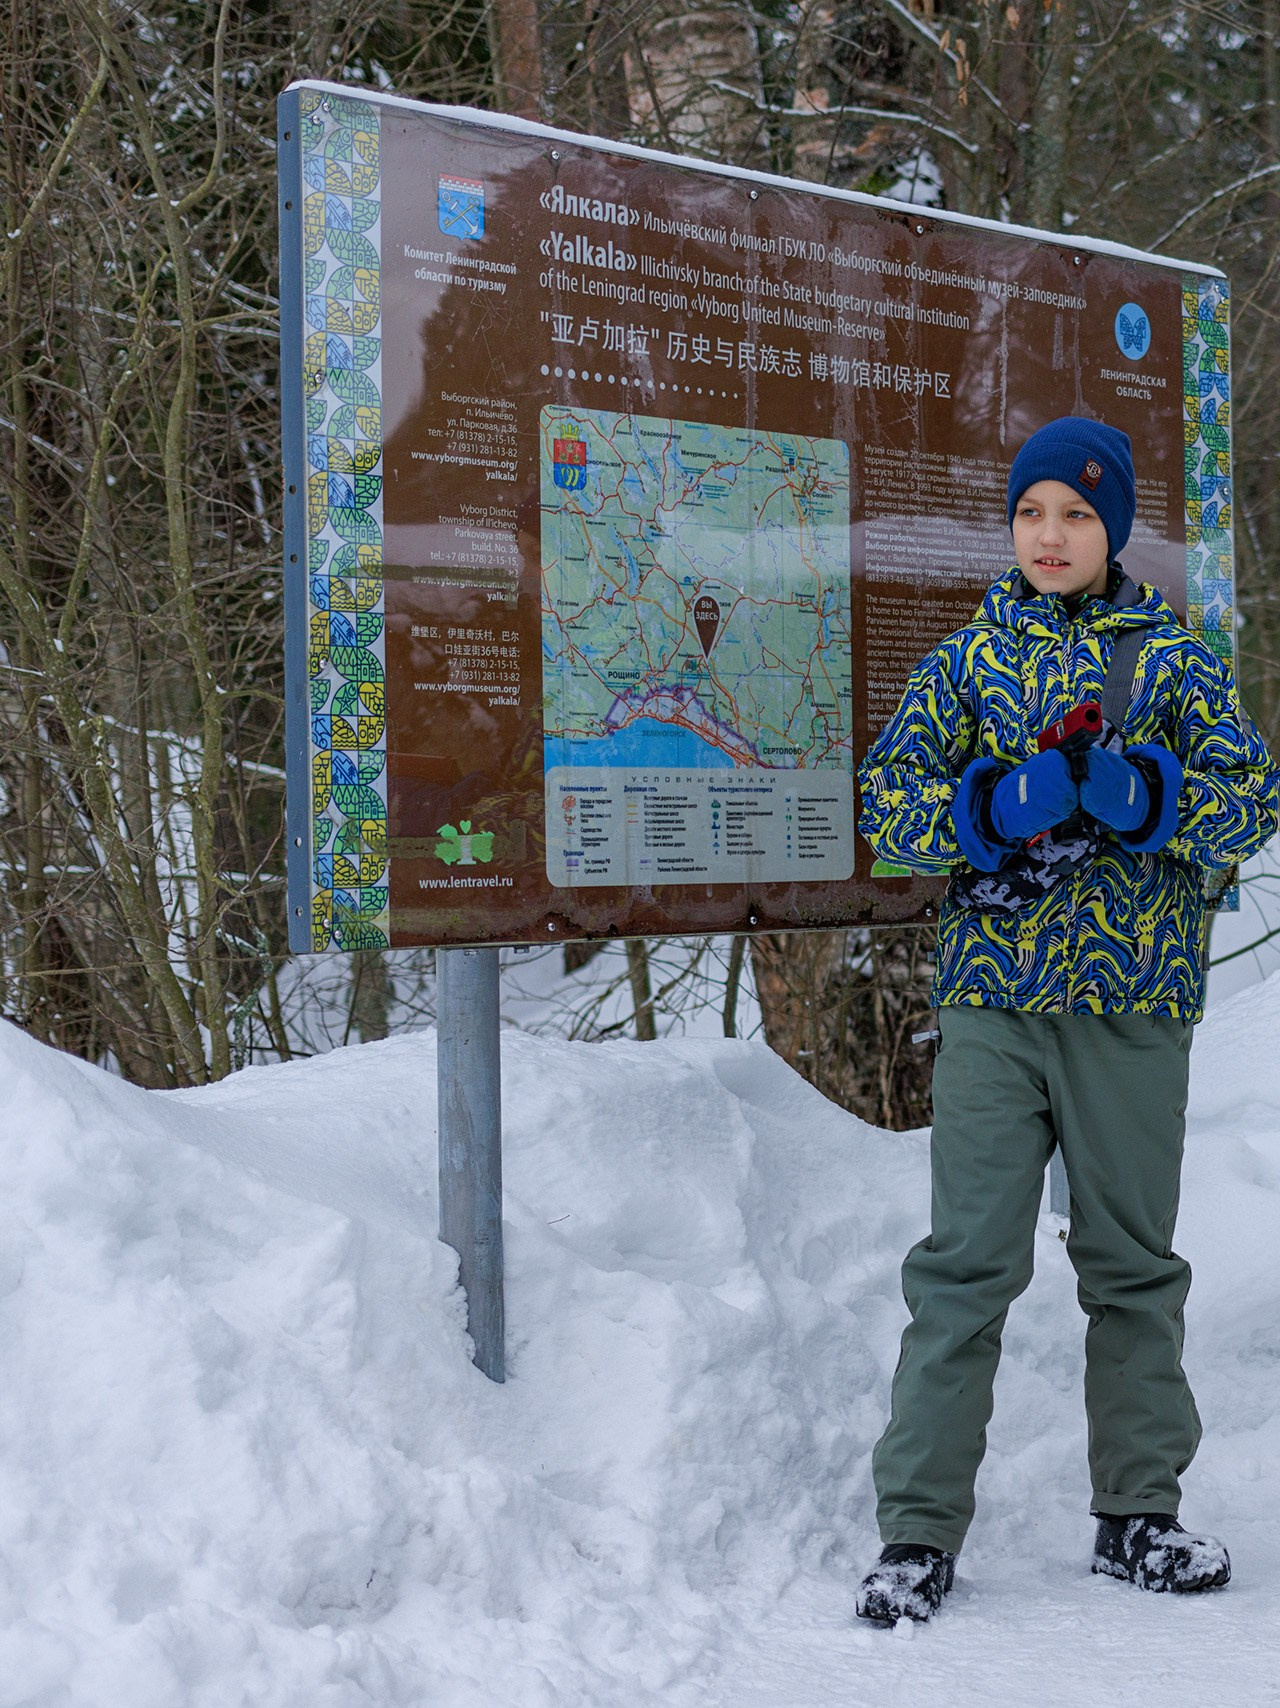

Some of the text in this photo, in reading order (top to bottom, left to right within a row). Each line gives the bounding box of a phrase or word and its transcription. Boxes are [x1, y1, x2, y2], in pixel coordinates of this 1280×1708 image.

[539, 185, 1087, 309] «Ялкала» Ильичёвский филиал ГБУК ЛО «Выборгский объединённый музей-заповедник»
[404, 245, 516, 274] Комитет Ленинградской
[415, 267, 506, 295] области по туризму
[539, 231, 970, 330] «Yalkala» Illichivsky branch of the State budgetary cultural institution
[539, 268, 885, 342] of the Leningrad region «Vyborg United Museum-Reserve»
[540, 311, 950, 399] "亚卢加拉" 历史与民族志 博物馆和保护区
[1100, 369, 1166, 388] ЛЕНИНГРАДСКАЯ
[1116, 386, 1152, 400] ОБЛАСТЬ
[442, 391, 517, 410] Выборгский район,
[466, 408, 473, 416] п.
[447, 418, 517, 433] ул. Парковая, д.36
[428, 428, 517, 446] тел: +7 (81378) 2-15-15,
[447, 442, 517, 458] +7 (931) 281-13-82
[864, 444, 885, 456] Музей
[887, 449, 908, 457] создан
[920, 452, 945, 462] октября
[947, 455, 961, 464] 1940
[962, 458, 976, 466] года
[978, 460, 995, 468] после
[411, 451, 518, 471] www.vyborgmuseum.org/
[865, 456, 902, 467] территории
[486, 471, 518, 482] yalkala/
[870, 468, 894, 478] августе
[917, 483, 931, 491] 1993
[933, 485, 946, 494] году
[460, 504, 518, 518] Vyborg District,
[439, 515, 475, 526] township
[476, 517, 484, 526] of
[455, 528, 518, 542] Parkovaya street,
[865, 530, 988, 550] Режим работы: 10.00 до
[472, 542, 518, 554] build. No. 36
[865, 541, 906, 553] Выборгское
[446, 552, 456, 561] +7
[458, 553, 486, 564] (81378)
[488, 555, 518, 566] 2-15-15,
[866, 574, 888, 584] (81378)
[941, 579, 970, 589] 210-5555,
[963, 571, 982, 582] центр
[701, 601, 713, 609] ВЫ
[866, 594, 878, 603] The
[880, 597, 905, 605] museum
[921, 599, 943, 607] created
[696, 612, 719, 621] ЗДЕСЬ
[866, 606, 871, 614] is
[873, 607, 890, 615] home
[914, 608, 935, 617] Finnish
[937, 610, 969, 620] farmsteads
[867, 616, 898, 625] Parviainen
[900, 618, 918, 628] family
[927, 620, 947, 630] August
[879, 628, 911, 637] Provisional
[895, 639, 906, 647] and
[867, 648, 889, 656] ancient
[891, 649, 907, 657] times
[448, 659, 520, 670] +7 (81378) 2-15-15,
[867, 660, 899, 669] region, the
[450, 671, 520, 682] +7 (931) 281-13-82
[608, 671, 640, 679] РОЩИНО
[867, 670, 877, 678] the
[414, 682, 520, 695] www.vyborgmuseum.org/
[867, 681, 895, 691] Working
[489, 697, 520, 707] yalkala/
[868, 702, 884, 710] build.
[868, 723, 878, 731] No.
[763, 747, 802, 755] СЕРТОЛОВО
[419, 875, 513, 889] www.lentravel.ru
